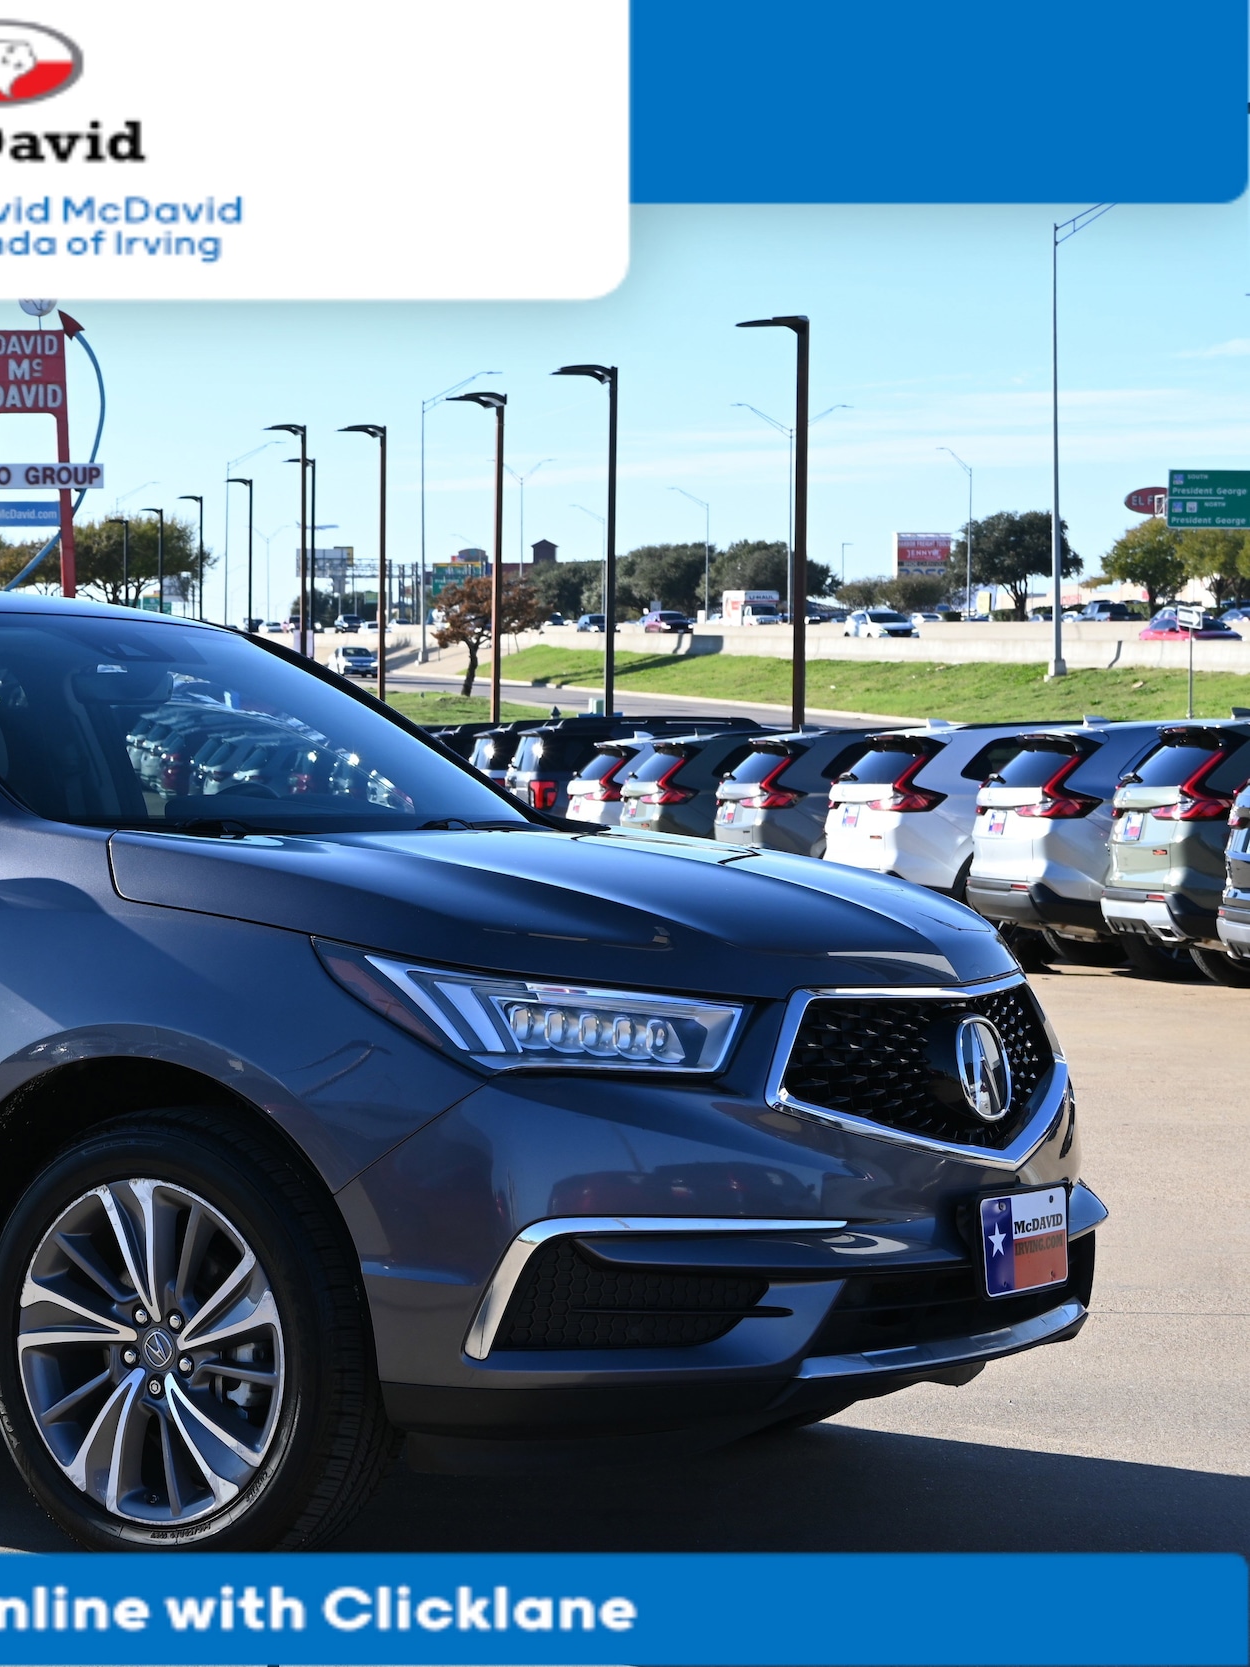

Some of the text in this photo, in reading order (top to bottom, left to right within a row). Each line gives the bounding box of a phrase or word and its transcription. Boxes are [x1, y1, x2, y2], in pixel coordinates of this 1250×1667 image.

[24, 466, 102, 487] GROUP
[1172, 487, 1247, 496] President George
[1131, 495, 1145, 506] EL
[1215, 517, 1247, 526] George
[1014, 1214, 1062, 1234] McDAVID
[1015, 1235, 1062, 1255] IRVING.COM
